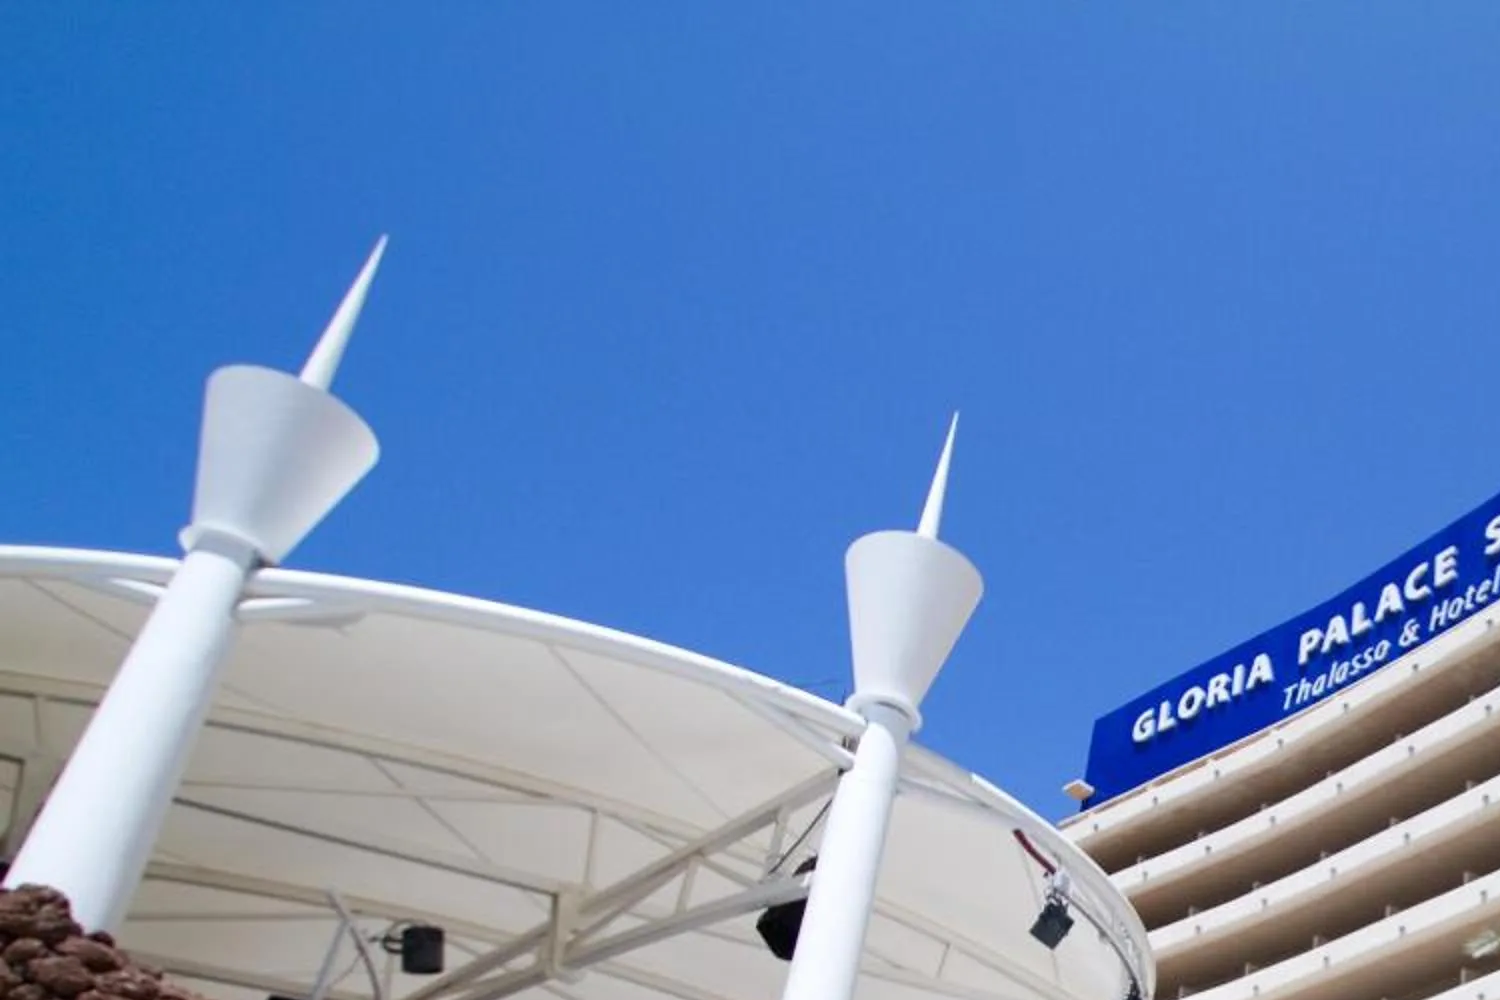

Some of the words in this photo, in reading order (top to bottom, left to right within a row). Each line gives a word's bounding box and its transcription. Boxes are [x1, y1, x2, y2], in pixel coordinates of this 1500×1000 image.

[1131, 652, 1274, 742] GLORIA
[1298, 546, 1458, 665] PALACE
[1283, 639, 1391, 710] Thalasso
[1399, 619, 1420, 647] &
